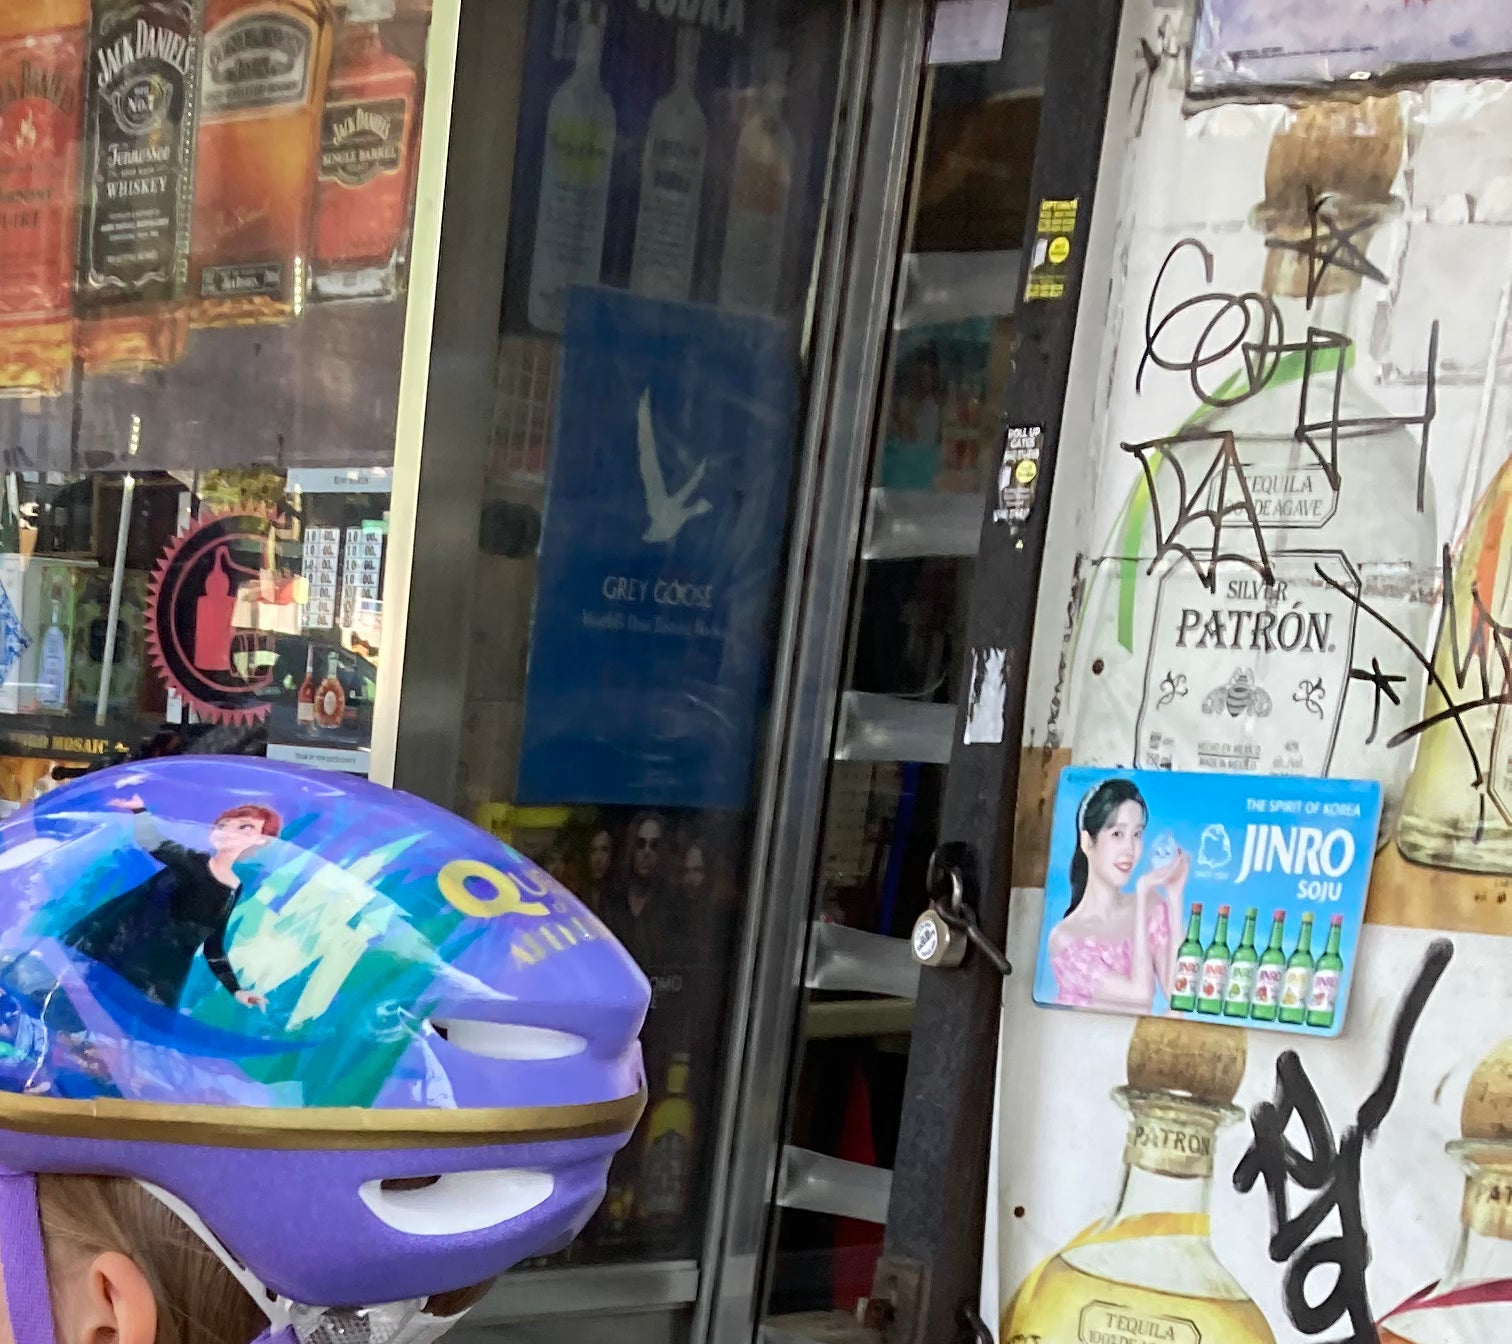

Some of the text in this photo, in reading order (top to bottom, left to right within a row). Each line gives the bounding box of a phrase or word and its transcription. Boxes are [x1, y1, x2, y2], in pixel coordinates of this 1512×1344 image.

[98, 35, 135, 88] JACK
[322, 146, 398, 167] SINGLE BARREL
[107, 176, 167, 198] WHISKEY
[1029, 427, 1040, 437] UP
[1010, 438, 1036, 449] GATES
[1271, 500, 1324, 516] AGAVE
[602, 576, 713, 608] GREY GOOSE
[1227, 580, 1288, 600] SILVER
[1176, 601, 1334, 654] PATRÓN
[1246, 798, 1361, 817] THE SPIRIT OF KOREA
[1234, 824, 1355, 884] JINRO
[1296, 879, 1343, 903] SOJU
[1106, 1312, 1175, 1341] TEQUILA
